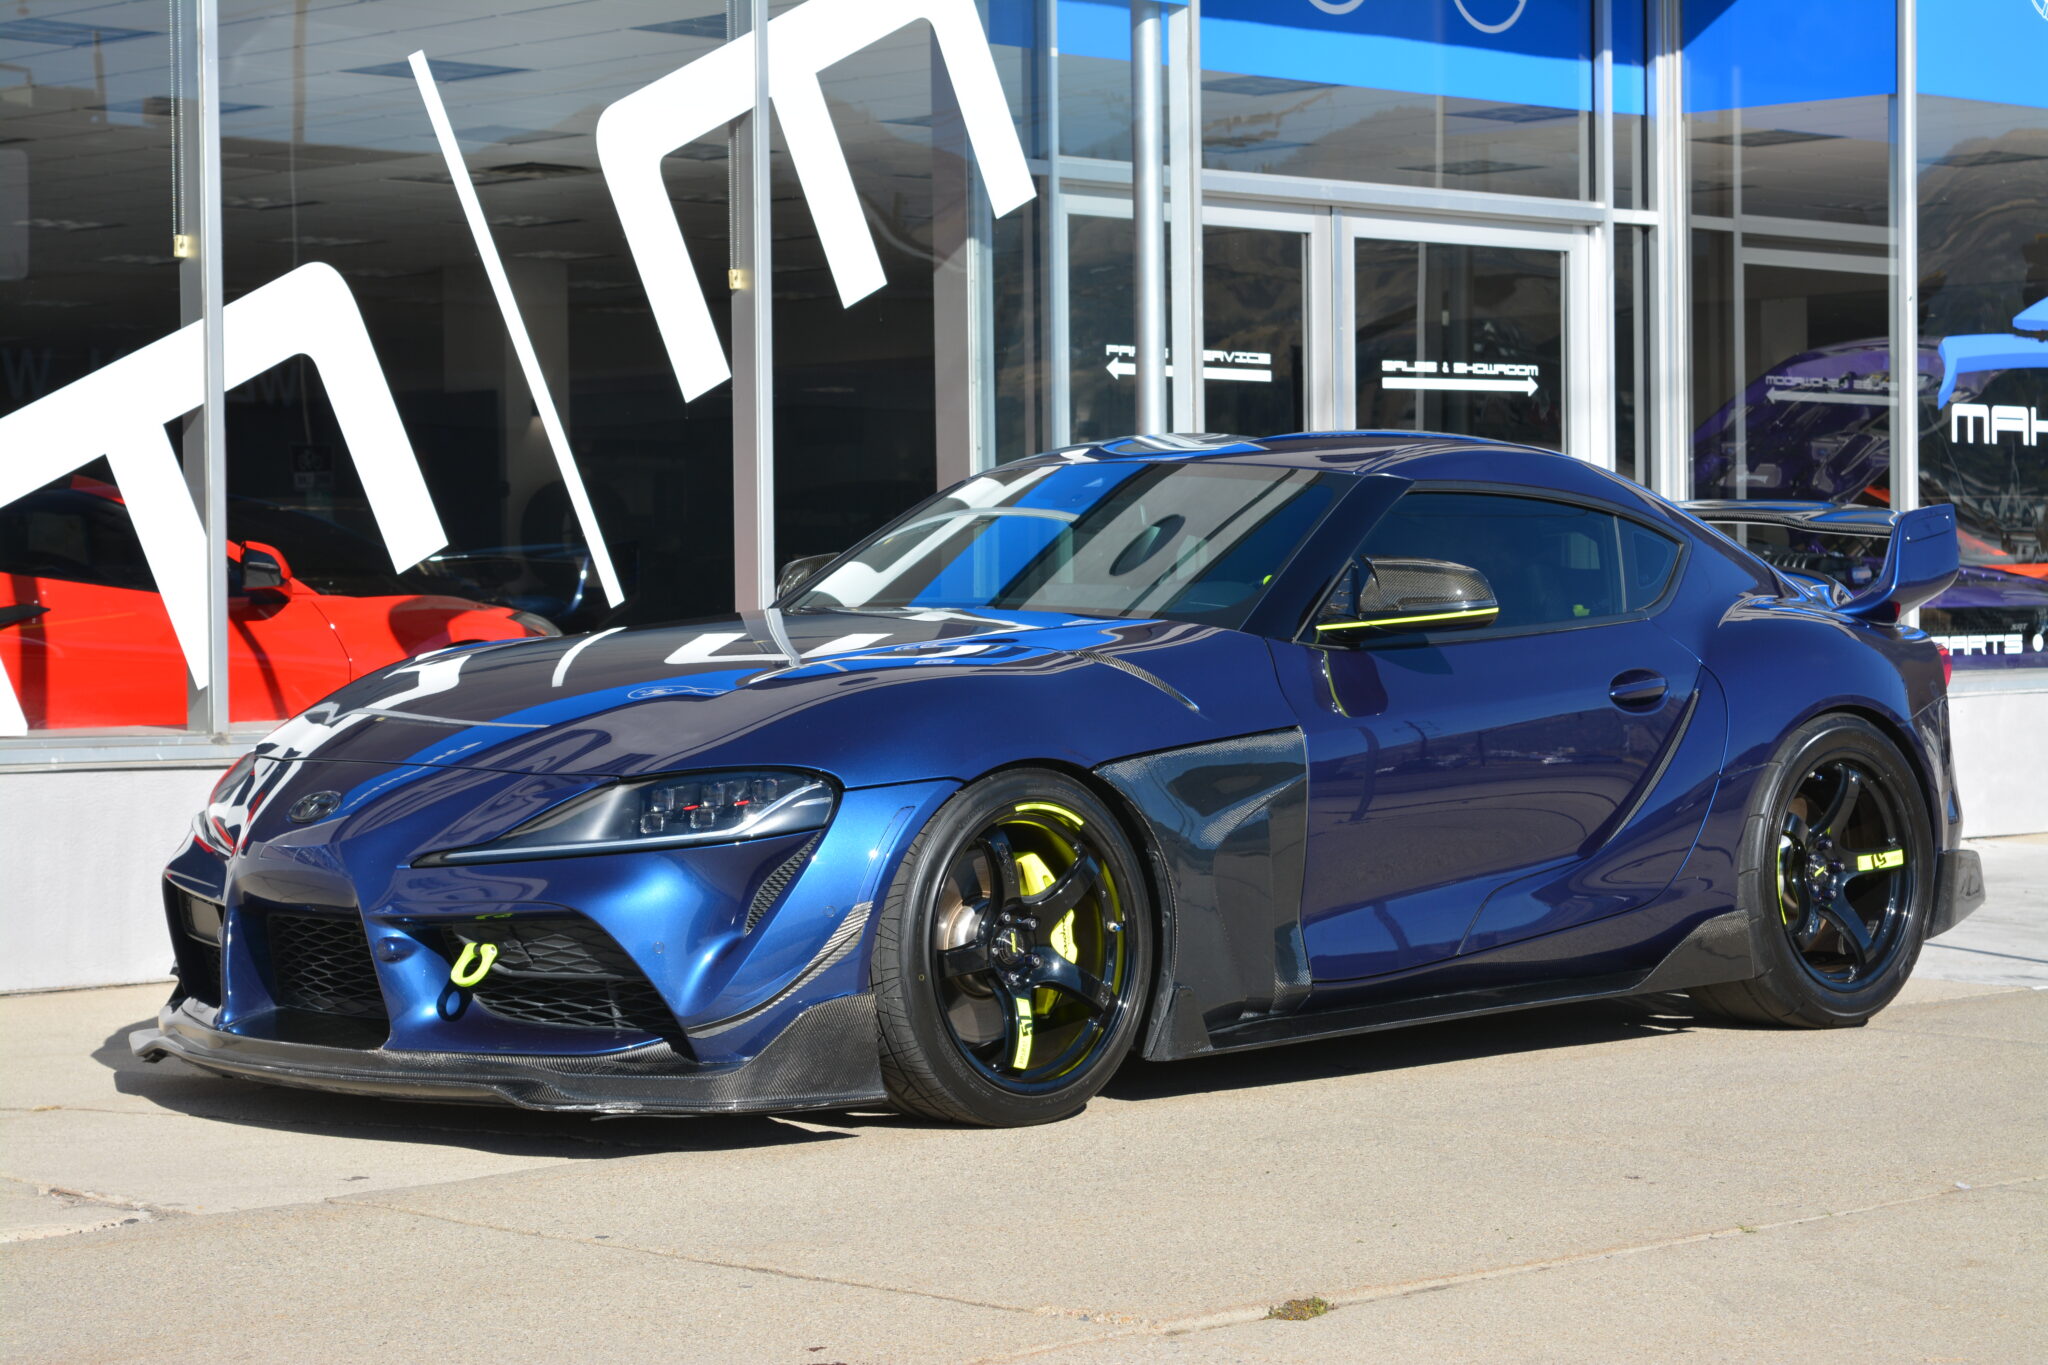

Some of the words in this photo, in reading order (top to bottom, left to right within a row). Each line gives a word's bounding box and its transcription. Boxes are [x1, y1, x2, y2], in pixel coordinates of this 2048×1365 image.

[1202, 350, 1271, 364] ERVICE
[1382, 360, 1437, 373] SALES
[1453, 362, 1539, 376] SHOWROOM
